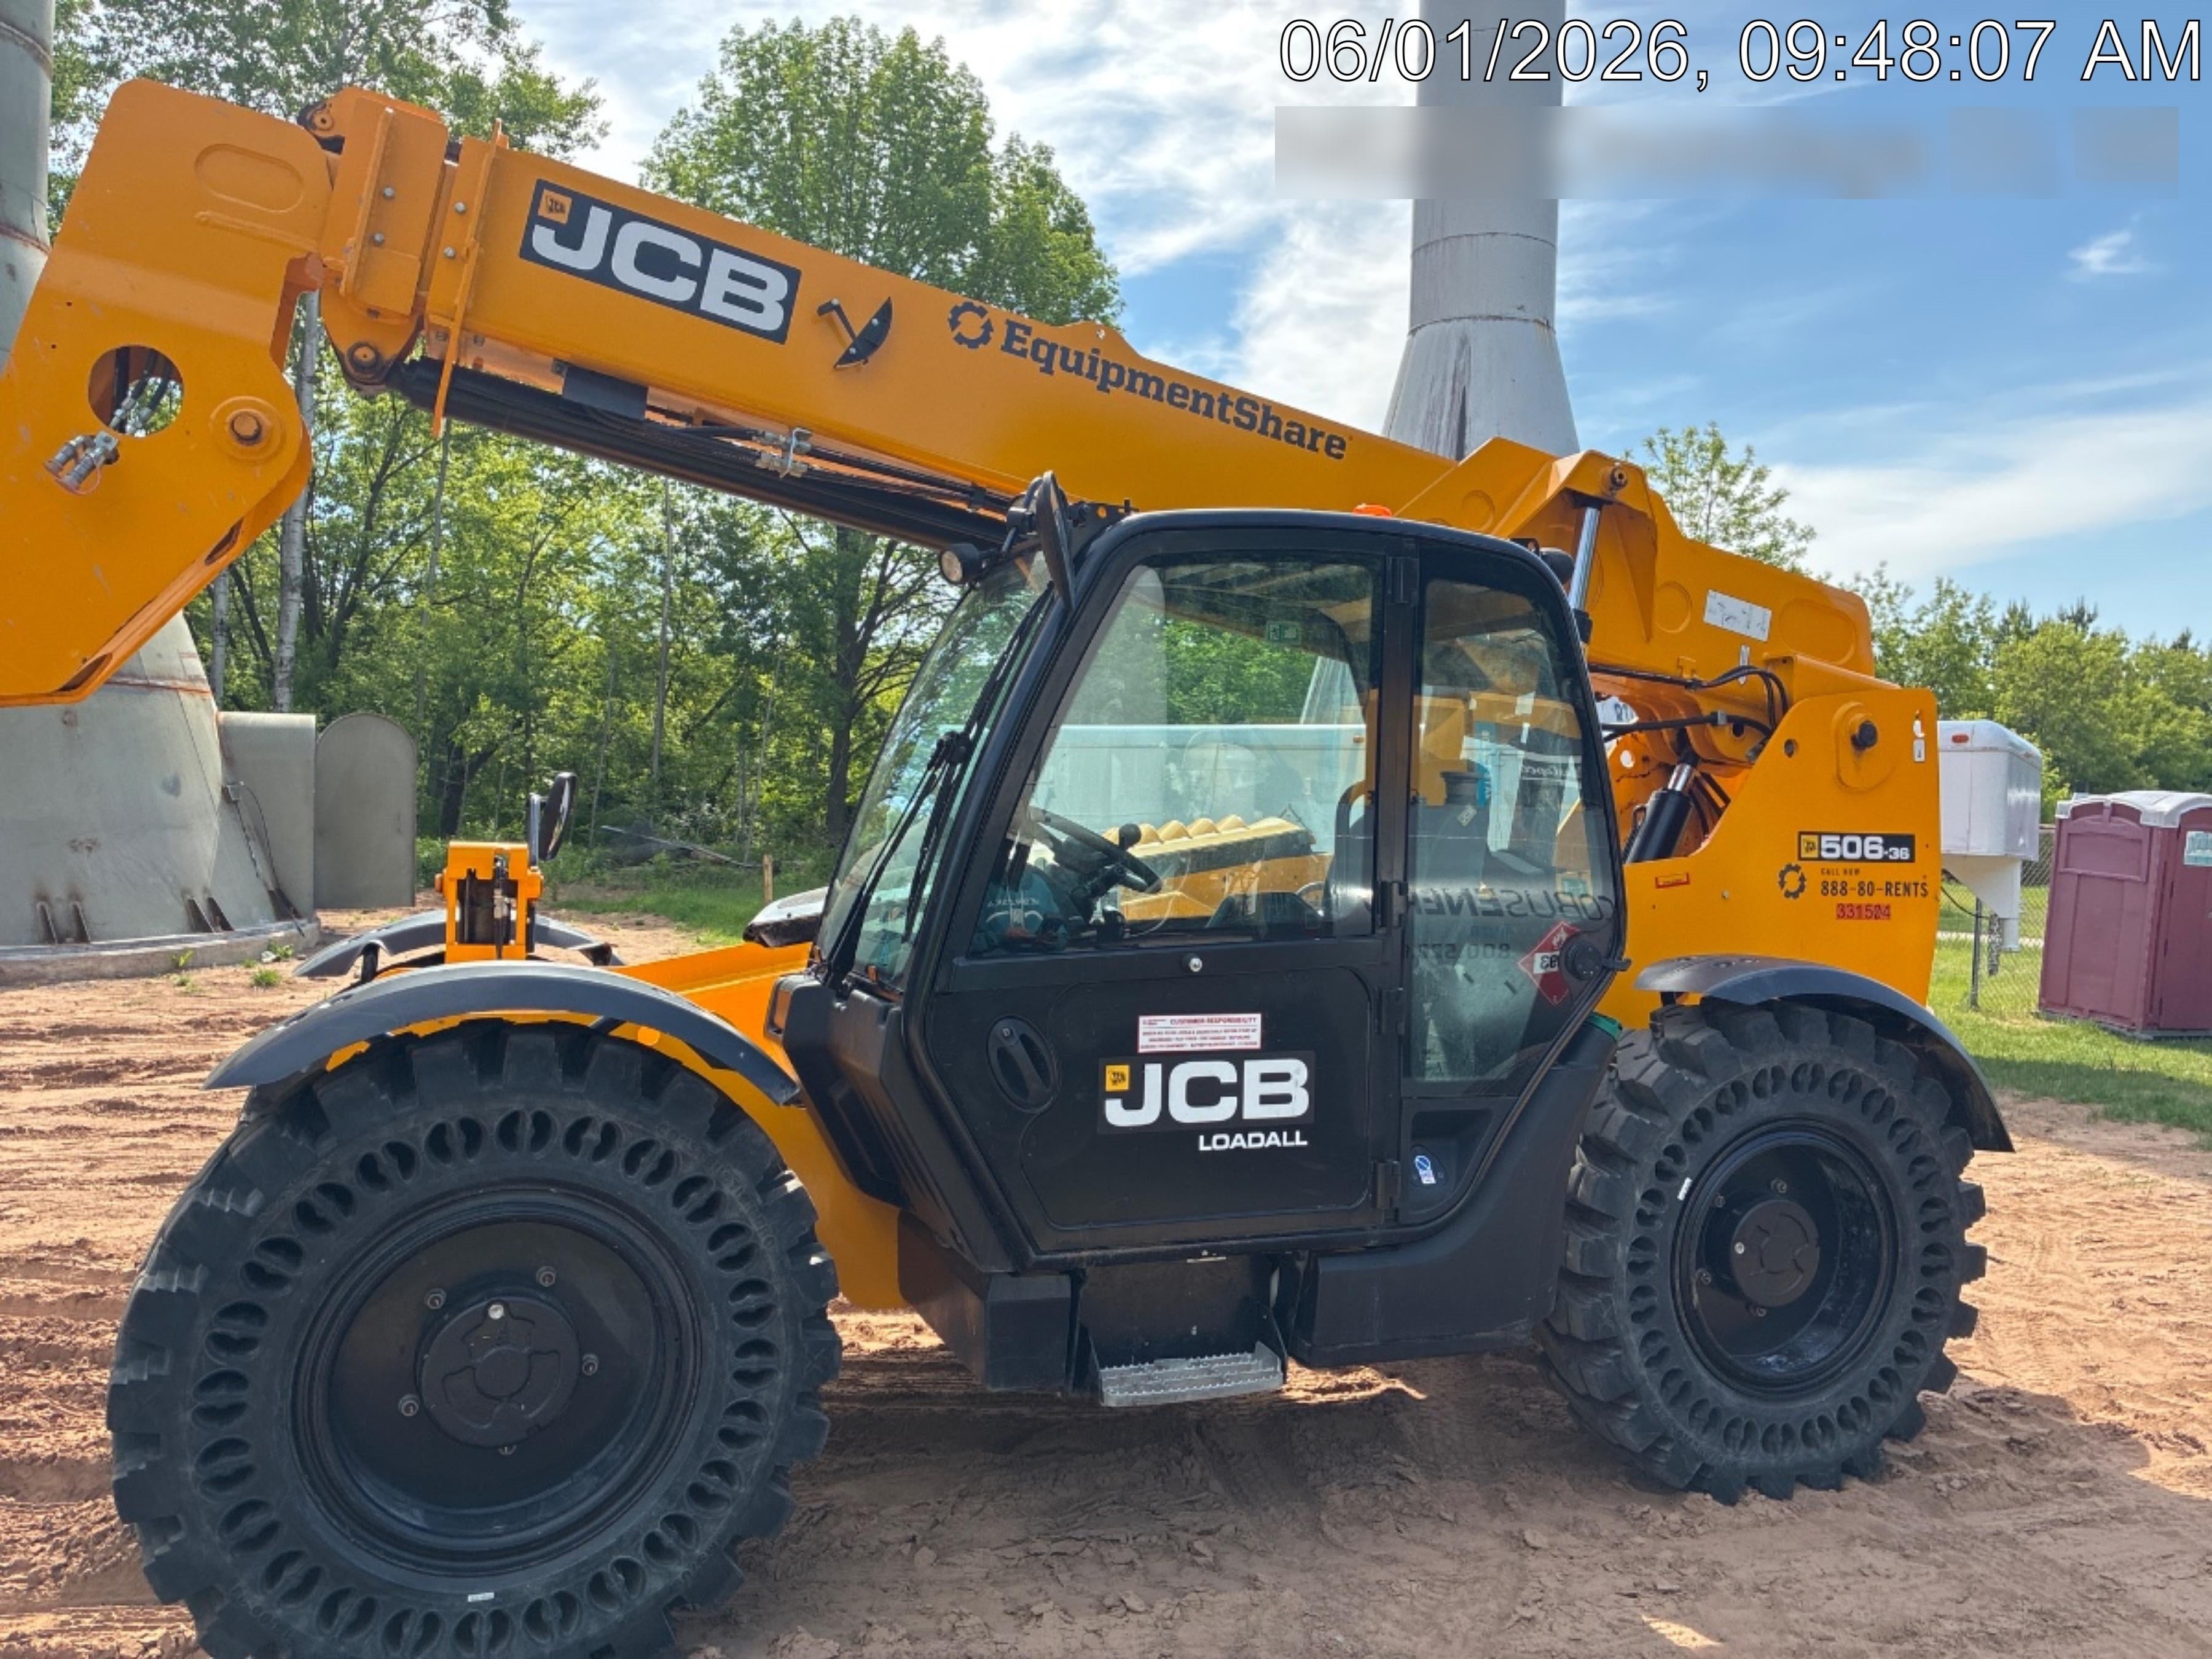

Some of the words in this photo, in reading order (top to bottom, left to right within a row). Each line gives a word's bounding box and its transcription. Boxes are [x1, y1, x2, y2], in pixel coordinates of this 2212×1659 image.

[532, 206, 788, 331] JCB
[1000, 318, 1347, 460] EquipmentShare
[1821, 880, 1929, 898] 888-80-RENTS
[1105, 1058, 1309, 1127] JCB
[1199, 1130, 1308, 1151] LOADALL
